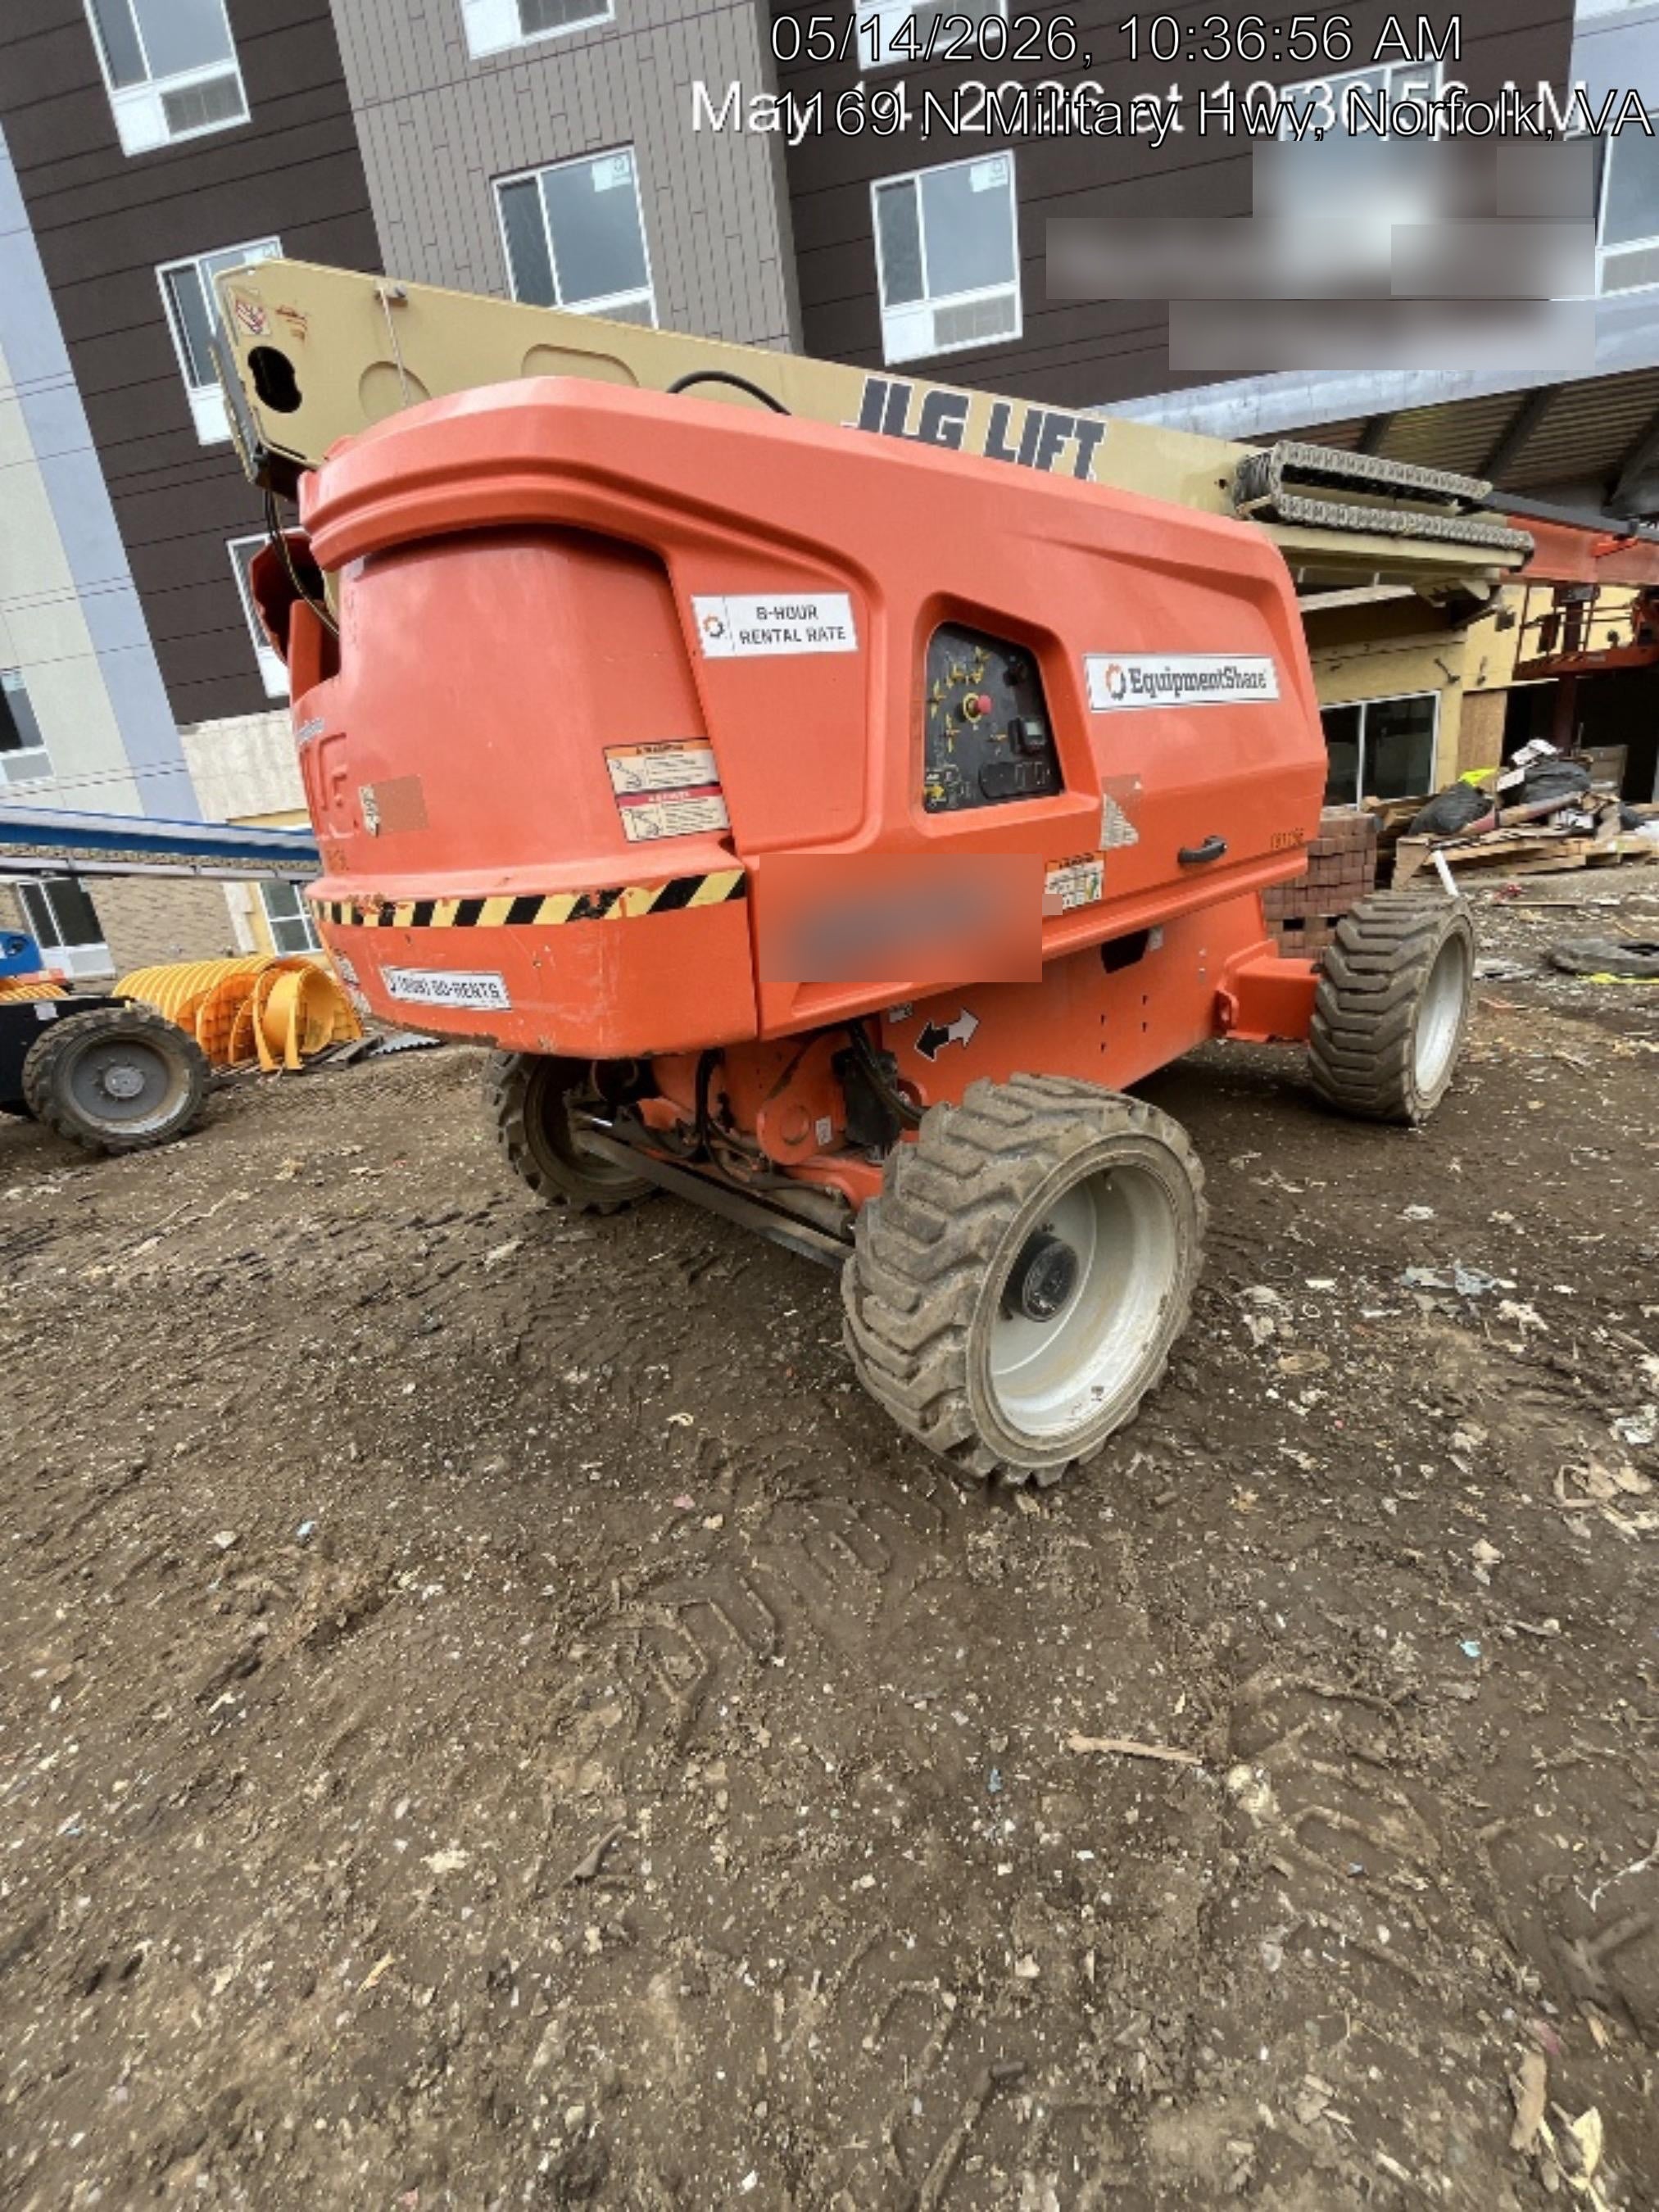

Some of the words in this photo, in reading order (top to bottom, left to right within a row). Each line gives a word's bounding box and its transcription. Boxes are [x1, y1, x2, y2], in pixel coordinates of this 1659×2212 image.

[855, 375, 972, 452] JLG
[982, 398, 1108, 481] LIFT
[739, 628, 803, 645] RENTAL
[806, 625, 847, 642] RATE
[1127, 665, 1267, 699] EquipmentShare
